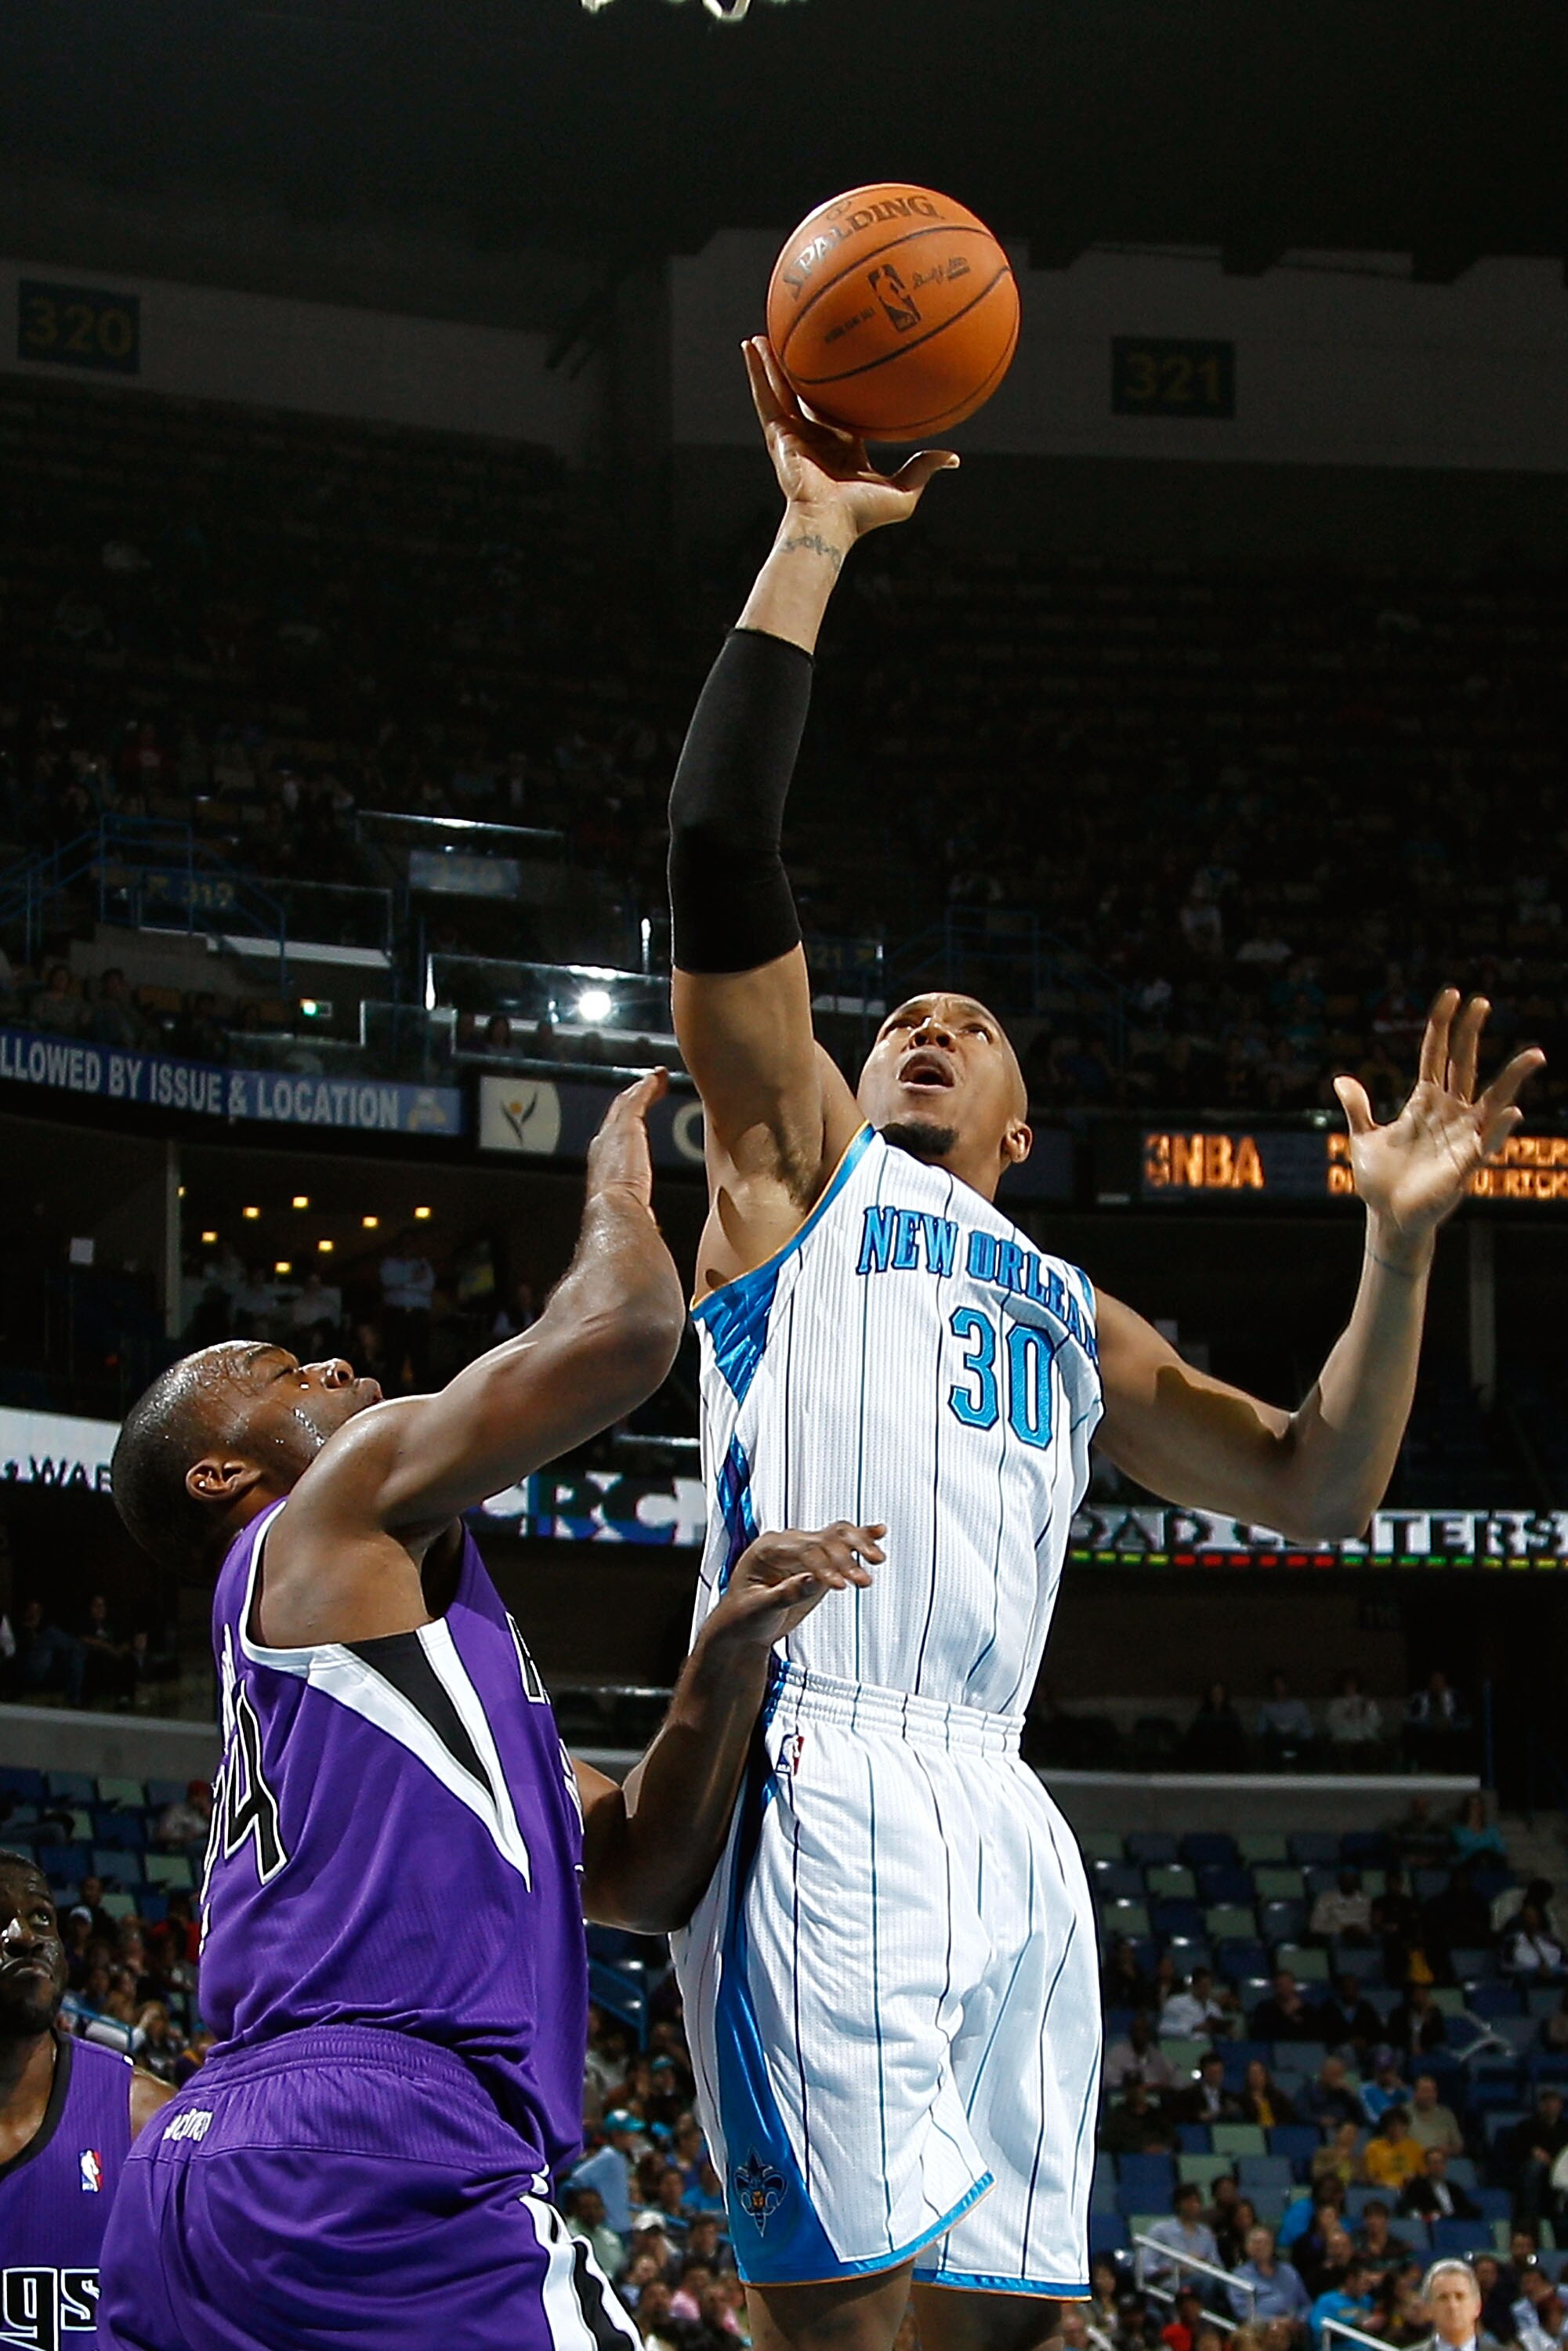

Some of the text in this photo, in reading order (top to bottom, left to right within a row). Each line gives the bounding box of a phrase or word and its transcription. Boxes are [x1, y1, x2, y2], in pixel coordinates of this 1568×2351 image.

[784, 195, 945, 301] SPALDING
[26, 296, 132, 357] 320
[1122, 353, 1220, 404] 321
[107, 1055, 143, 1100] BY
[149, 1062, 223, 1116] ISSUE
[227, 1074, 247, 1115] &
[256, 1077, 399, 1129] LOCATION
[856, 1204, 959, 1278] NEW
[947, 1305, 1053, 1451] 30
